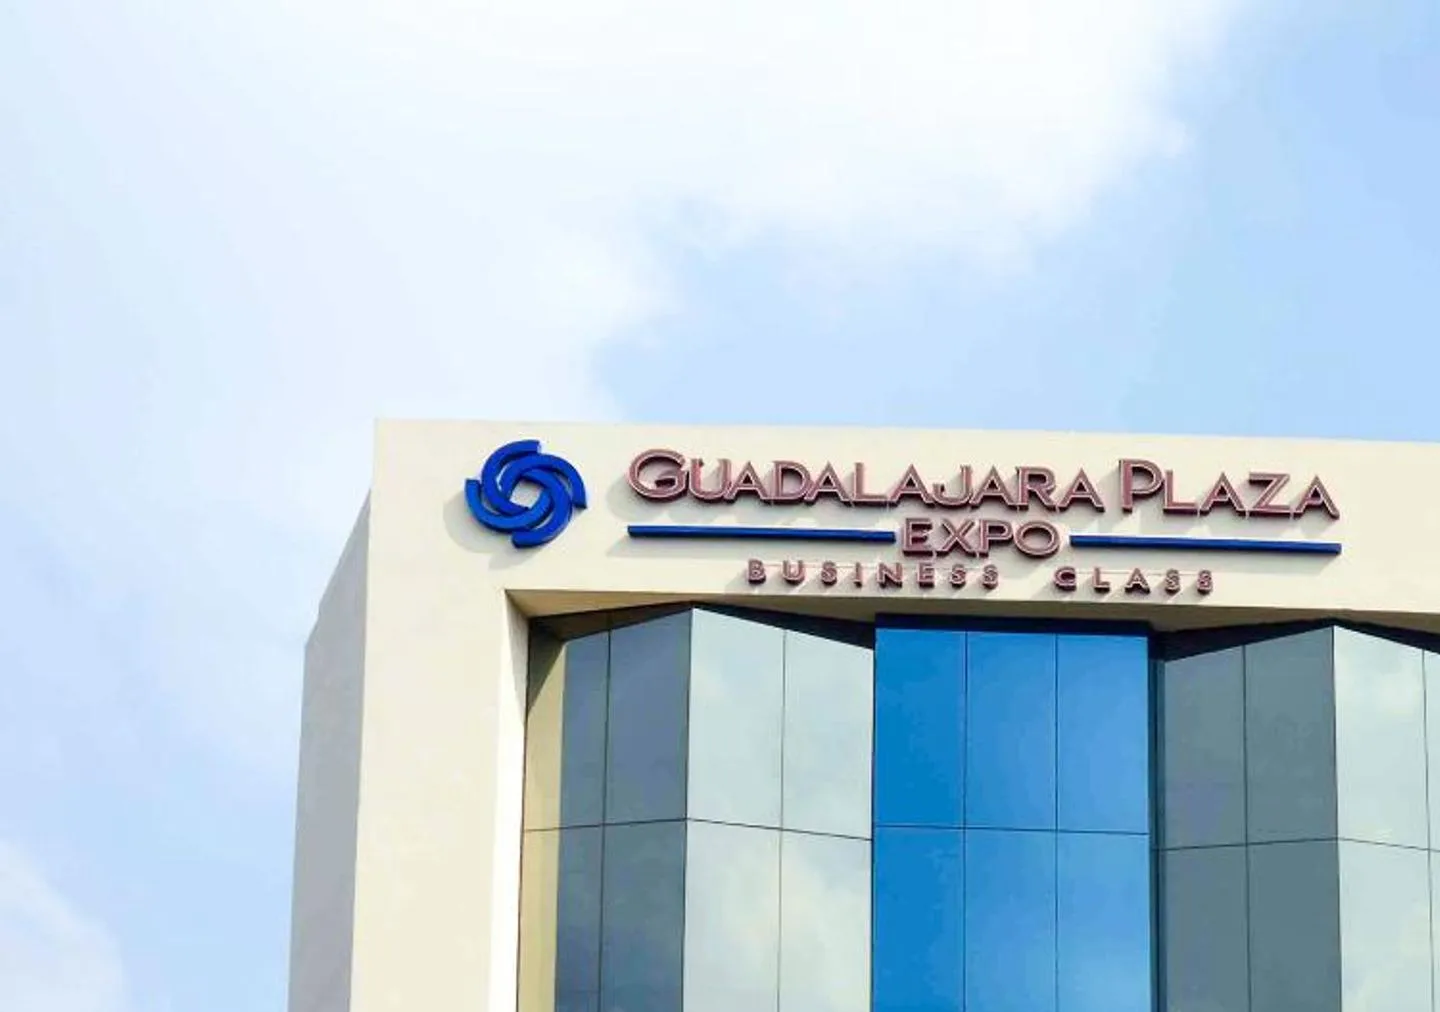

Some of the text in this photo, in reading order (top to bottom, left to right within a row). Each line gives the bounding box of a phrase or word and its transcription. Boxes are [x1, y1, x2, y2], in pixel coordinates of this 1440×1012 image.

[626, 448, 1340, 520] GUADALAJARA PLAZA
[902, 517, 1061, 558] EXPO
[748, 558, 1214, 594] BUSINESS CLASS
